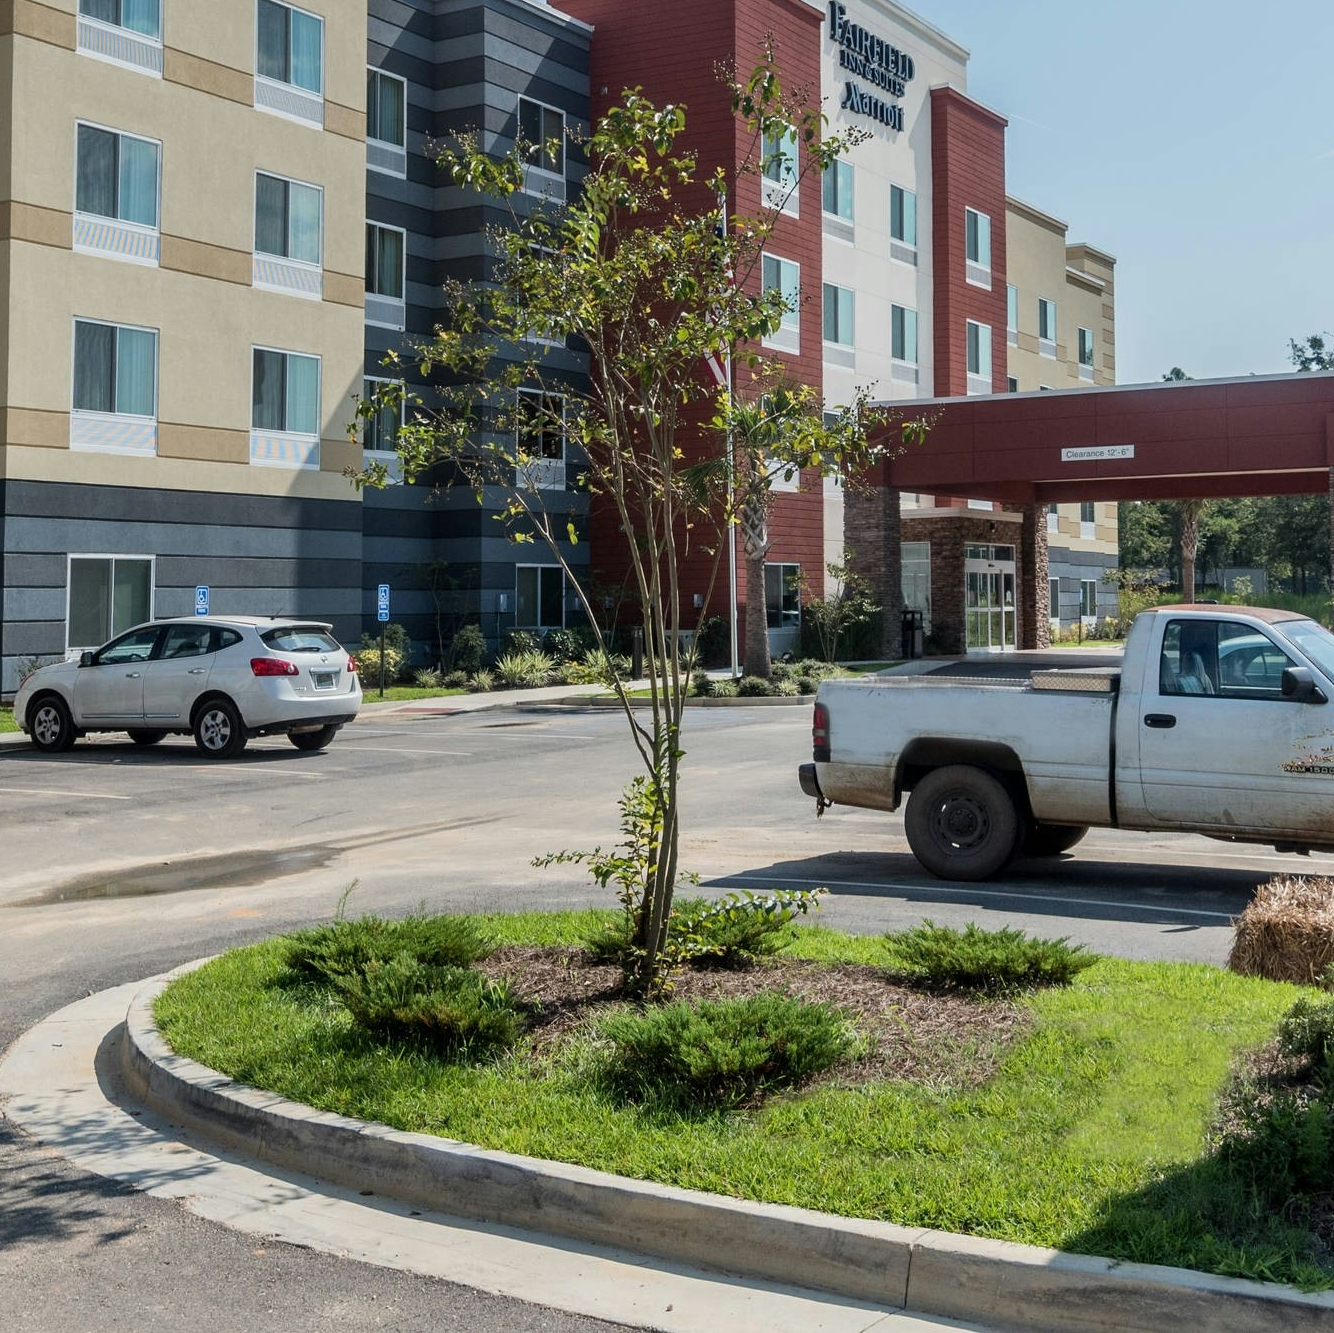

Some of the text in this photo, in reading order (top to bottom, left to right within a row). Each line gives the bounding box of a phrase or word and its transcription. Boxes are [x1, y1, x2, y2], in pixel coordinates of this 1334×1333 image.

[829, 0, 915, 81] FAIRFIELD
[840, 49, 866, 76] INN
[874, 69, 905, 98] SUITES
[841, 81, 904, 132] Marriott
[1066, 449, 1104, 459] Clearance
